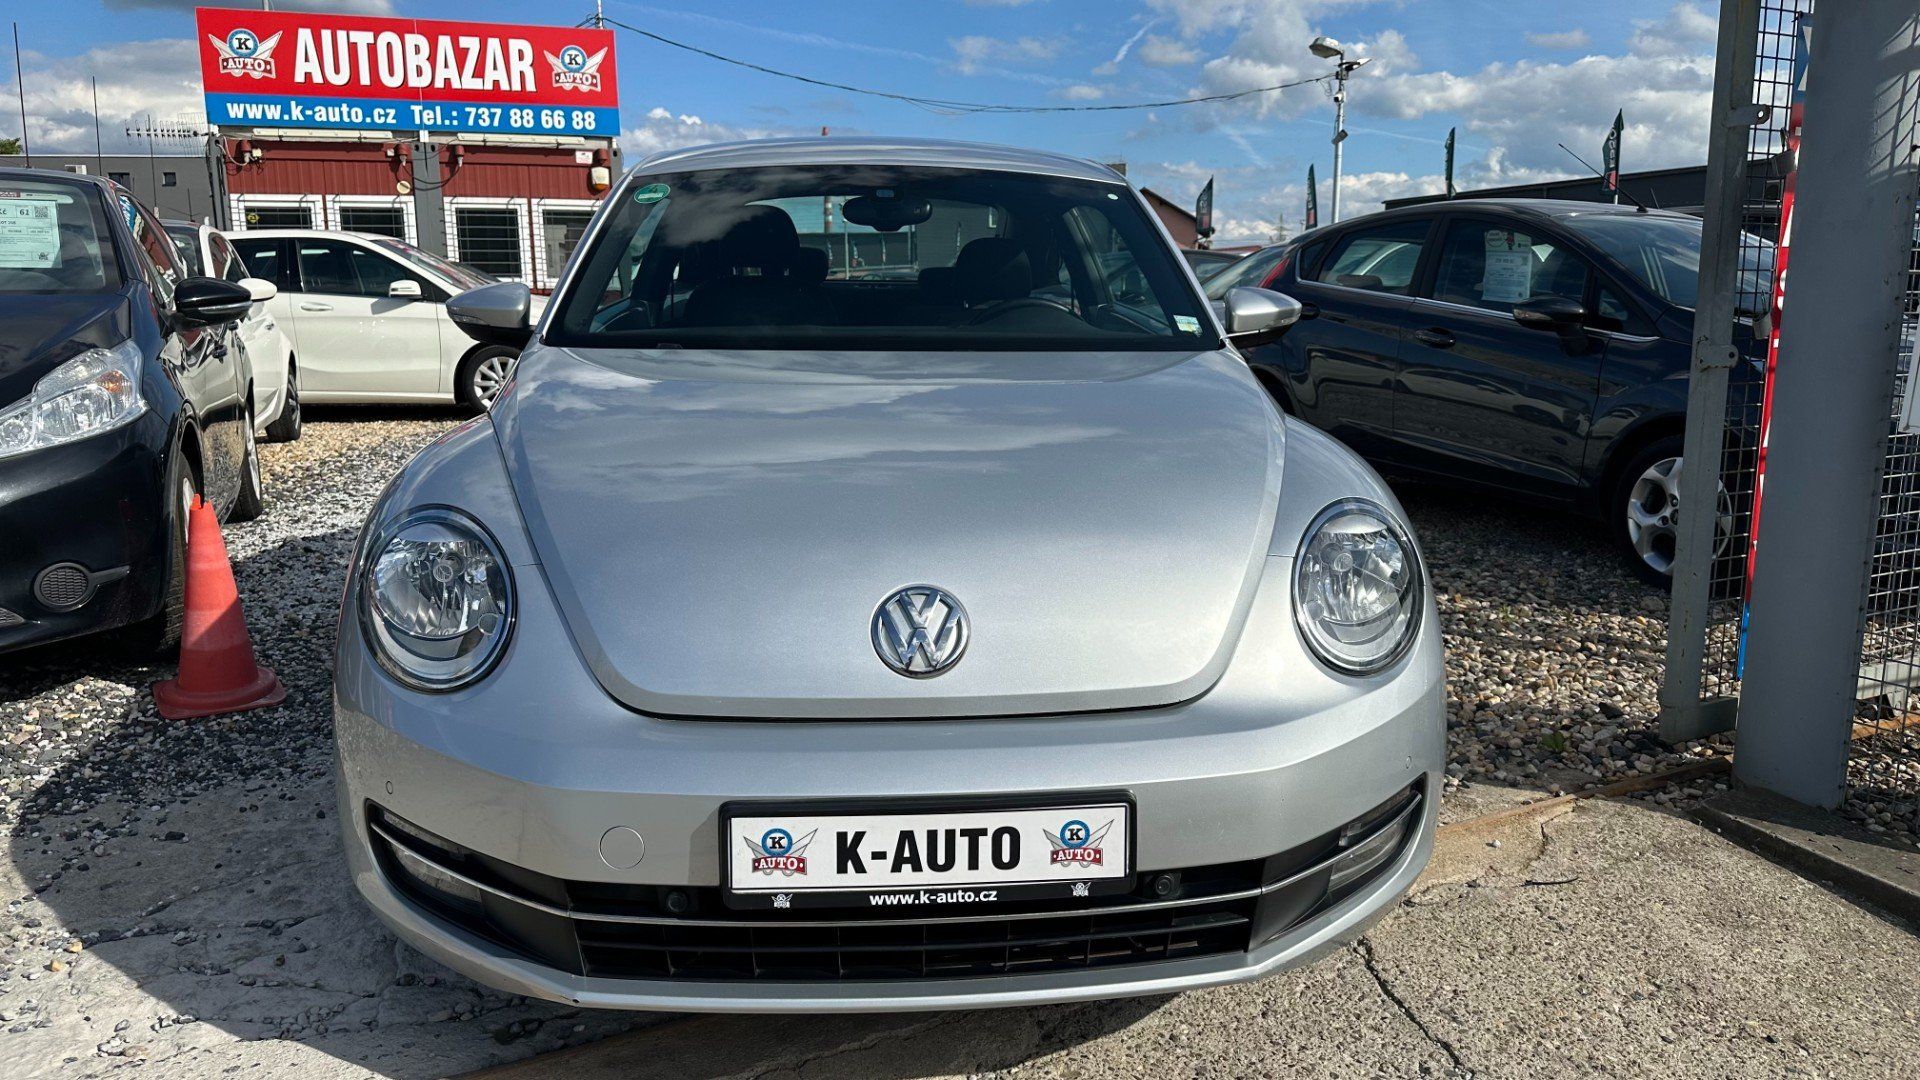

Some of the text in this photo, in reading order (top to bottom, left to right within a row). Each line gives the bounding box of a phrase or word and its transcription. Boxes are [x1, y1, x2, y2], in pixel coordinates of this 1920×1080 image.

[235, 37, 252, 50] K
[226, 58, 265, 72] AUTO
[294, 27, 537, 92] AUTOBAZAR
[566, 53, 581, 66] K
[558, 72, 592, 86] AUTO
[226, 101, 596, 130] www.k-auto.cz Tel.: 737 88 66 88
[19, 208, 30, 216] 61
[877, 587, 963, 672] VW
[1067, 828, 1084, 841] K
[769, 836, 786, 850] K
[836, 826, 1021, 875] K-AUTO
[1056, 848, 1095, 861] AUTO
[758, 857, 799, 870] AUTO
[869, 890, 998, 906] www.k-auto.cz
